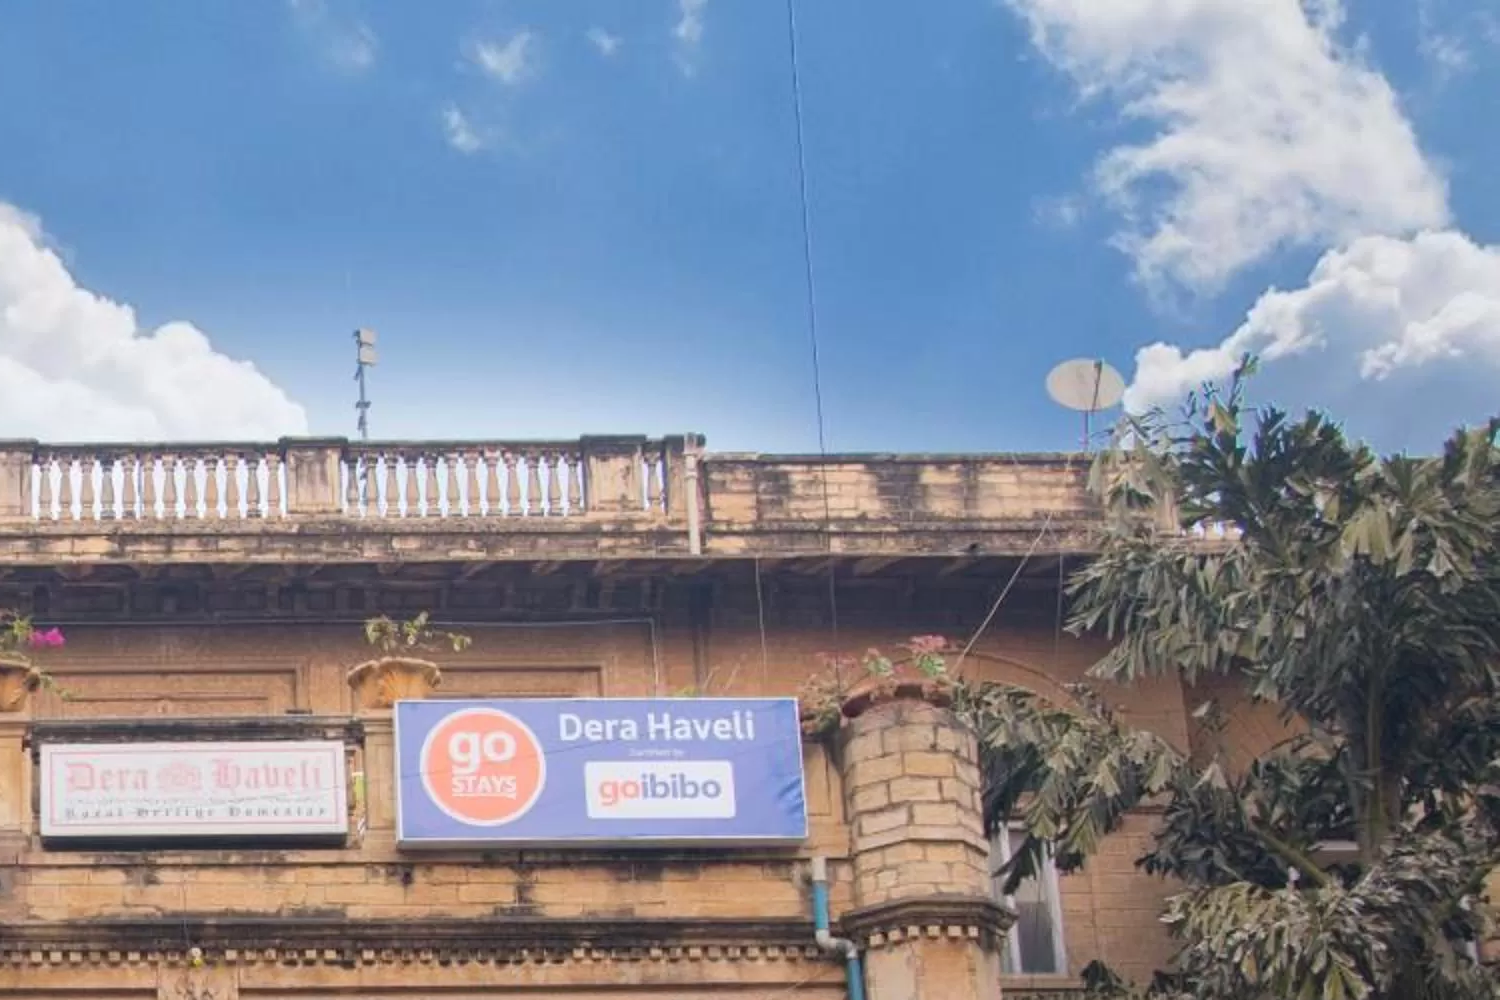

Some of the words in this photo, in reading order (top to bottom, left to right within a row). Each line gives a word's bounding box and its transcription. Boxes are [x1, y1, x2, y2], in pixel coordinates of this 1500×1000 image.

[559, 713, 637, 740] Dera
[649, 710, 755, 740] Haveli
[449, 730, 517, 775] go
[64, 760, 149, 792] Dera
[211, 757, 324, 793] Haveli
[451, 775, 517, 793] STAYS
[599, 772, 722, 806] goibibo
